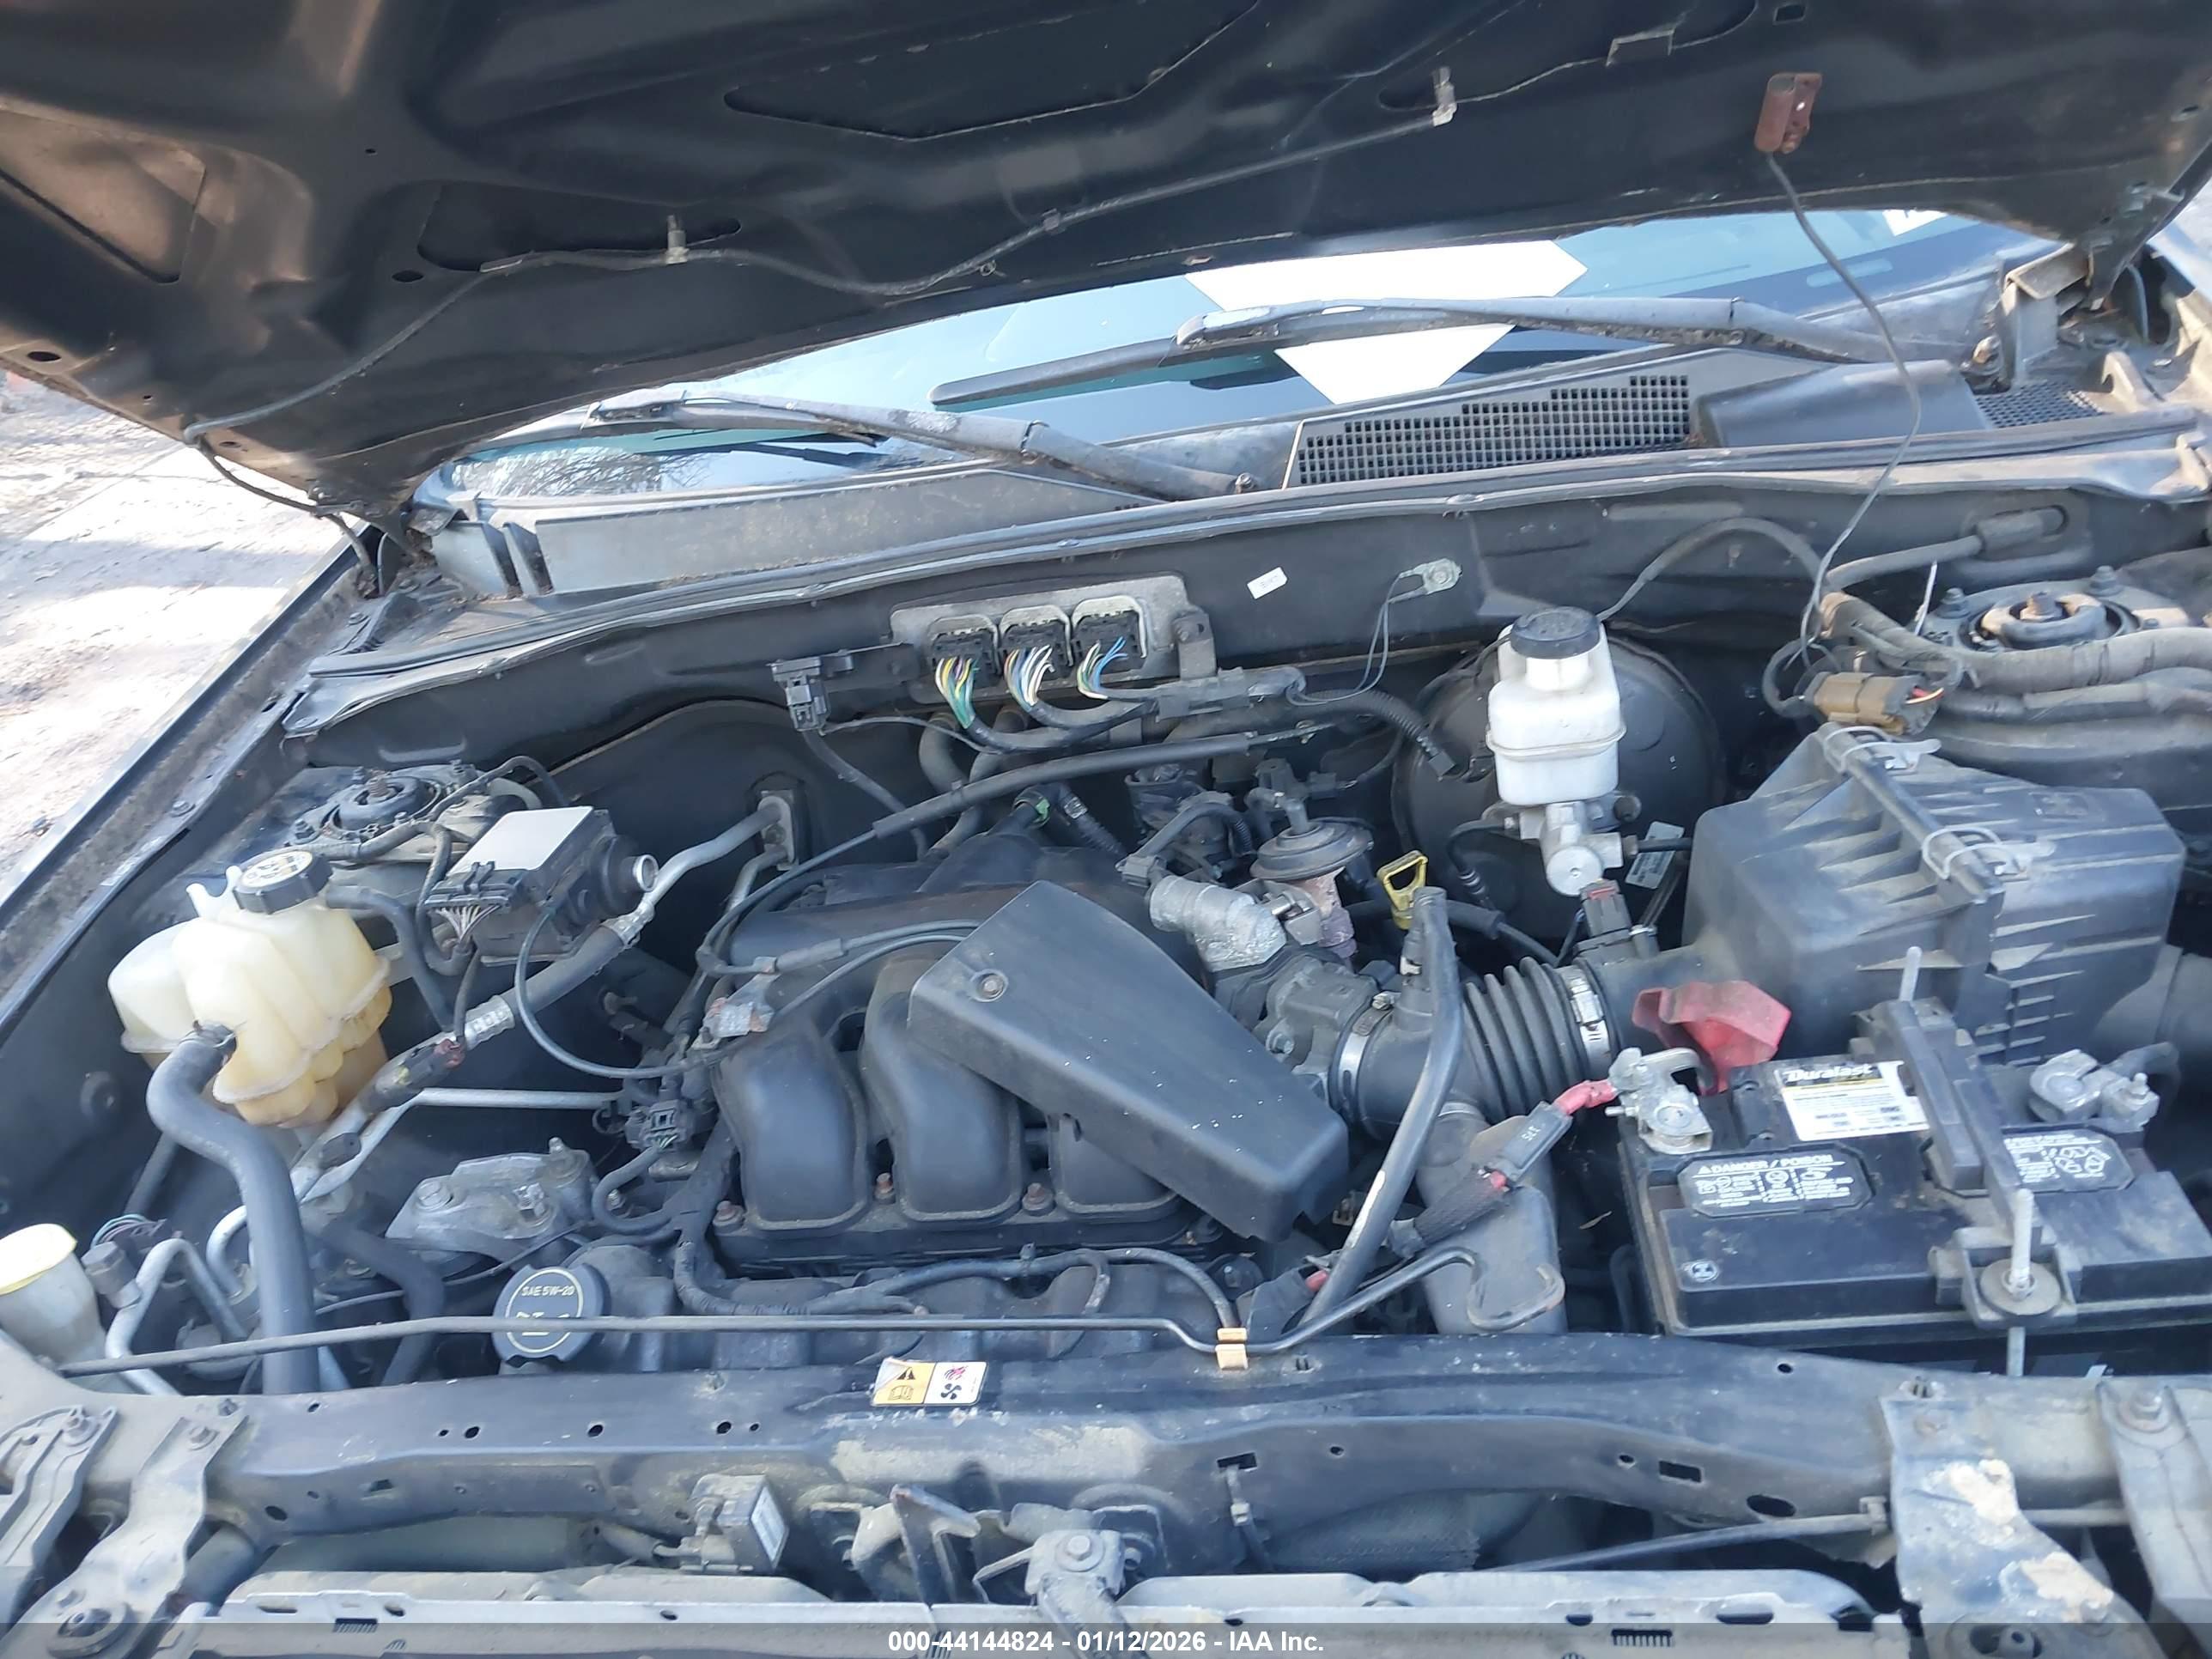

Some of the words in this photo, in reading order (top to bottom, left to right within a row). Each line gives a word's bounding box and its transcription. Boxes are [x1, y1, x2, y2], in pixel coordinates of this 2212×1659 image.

[1783, 1063, 1875, 1083] Duralast
[1711, 1160, 1769, 1174] DANGER
[1780, 1154, 1834, 1167] POISON
[521, 1285, 543, 1297] SAE
[542, 1285, 575, 1297] 5W-20
